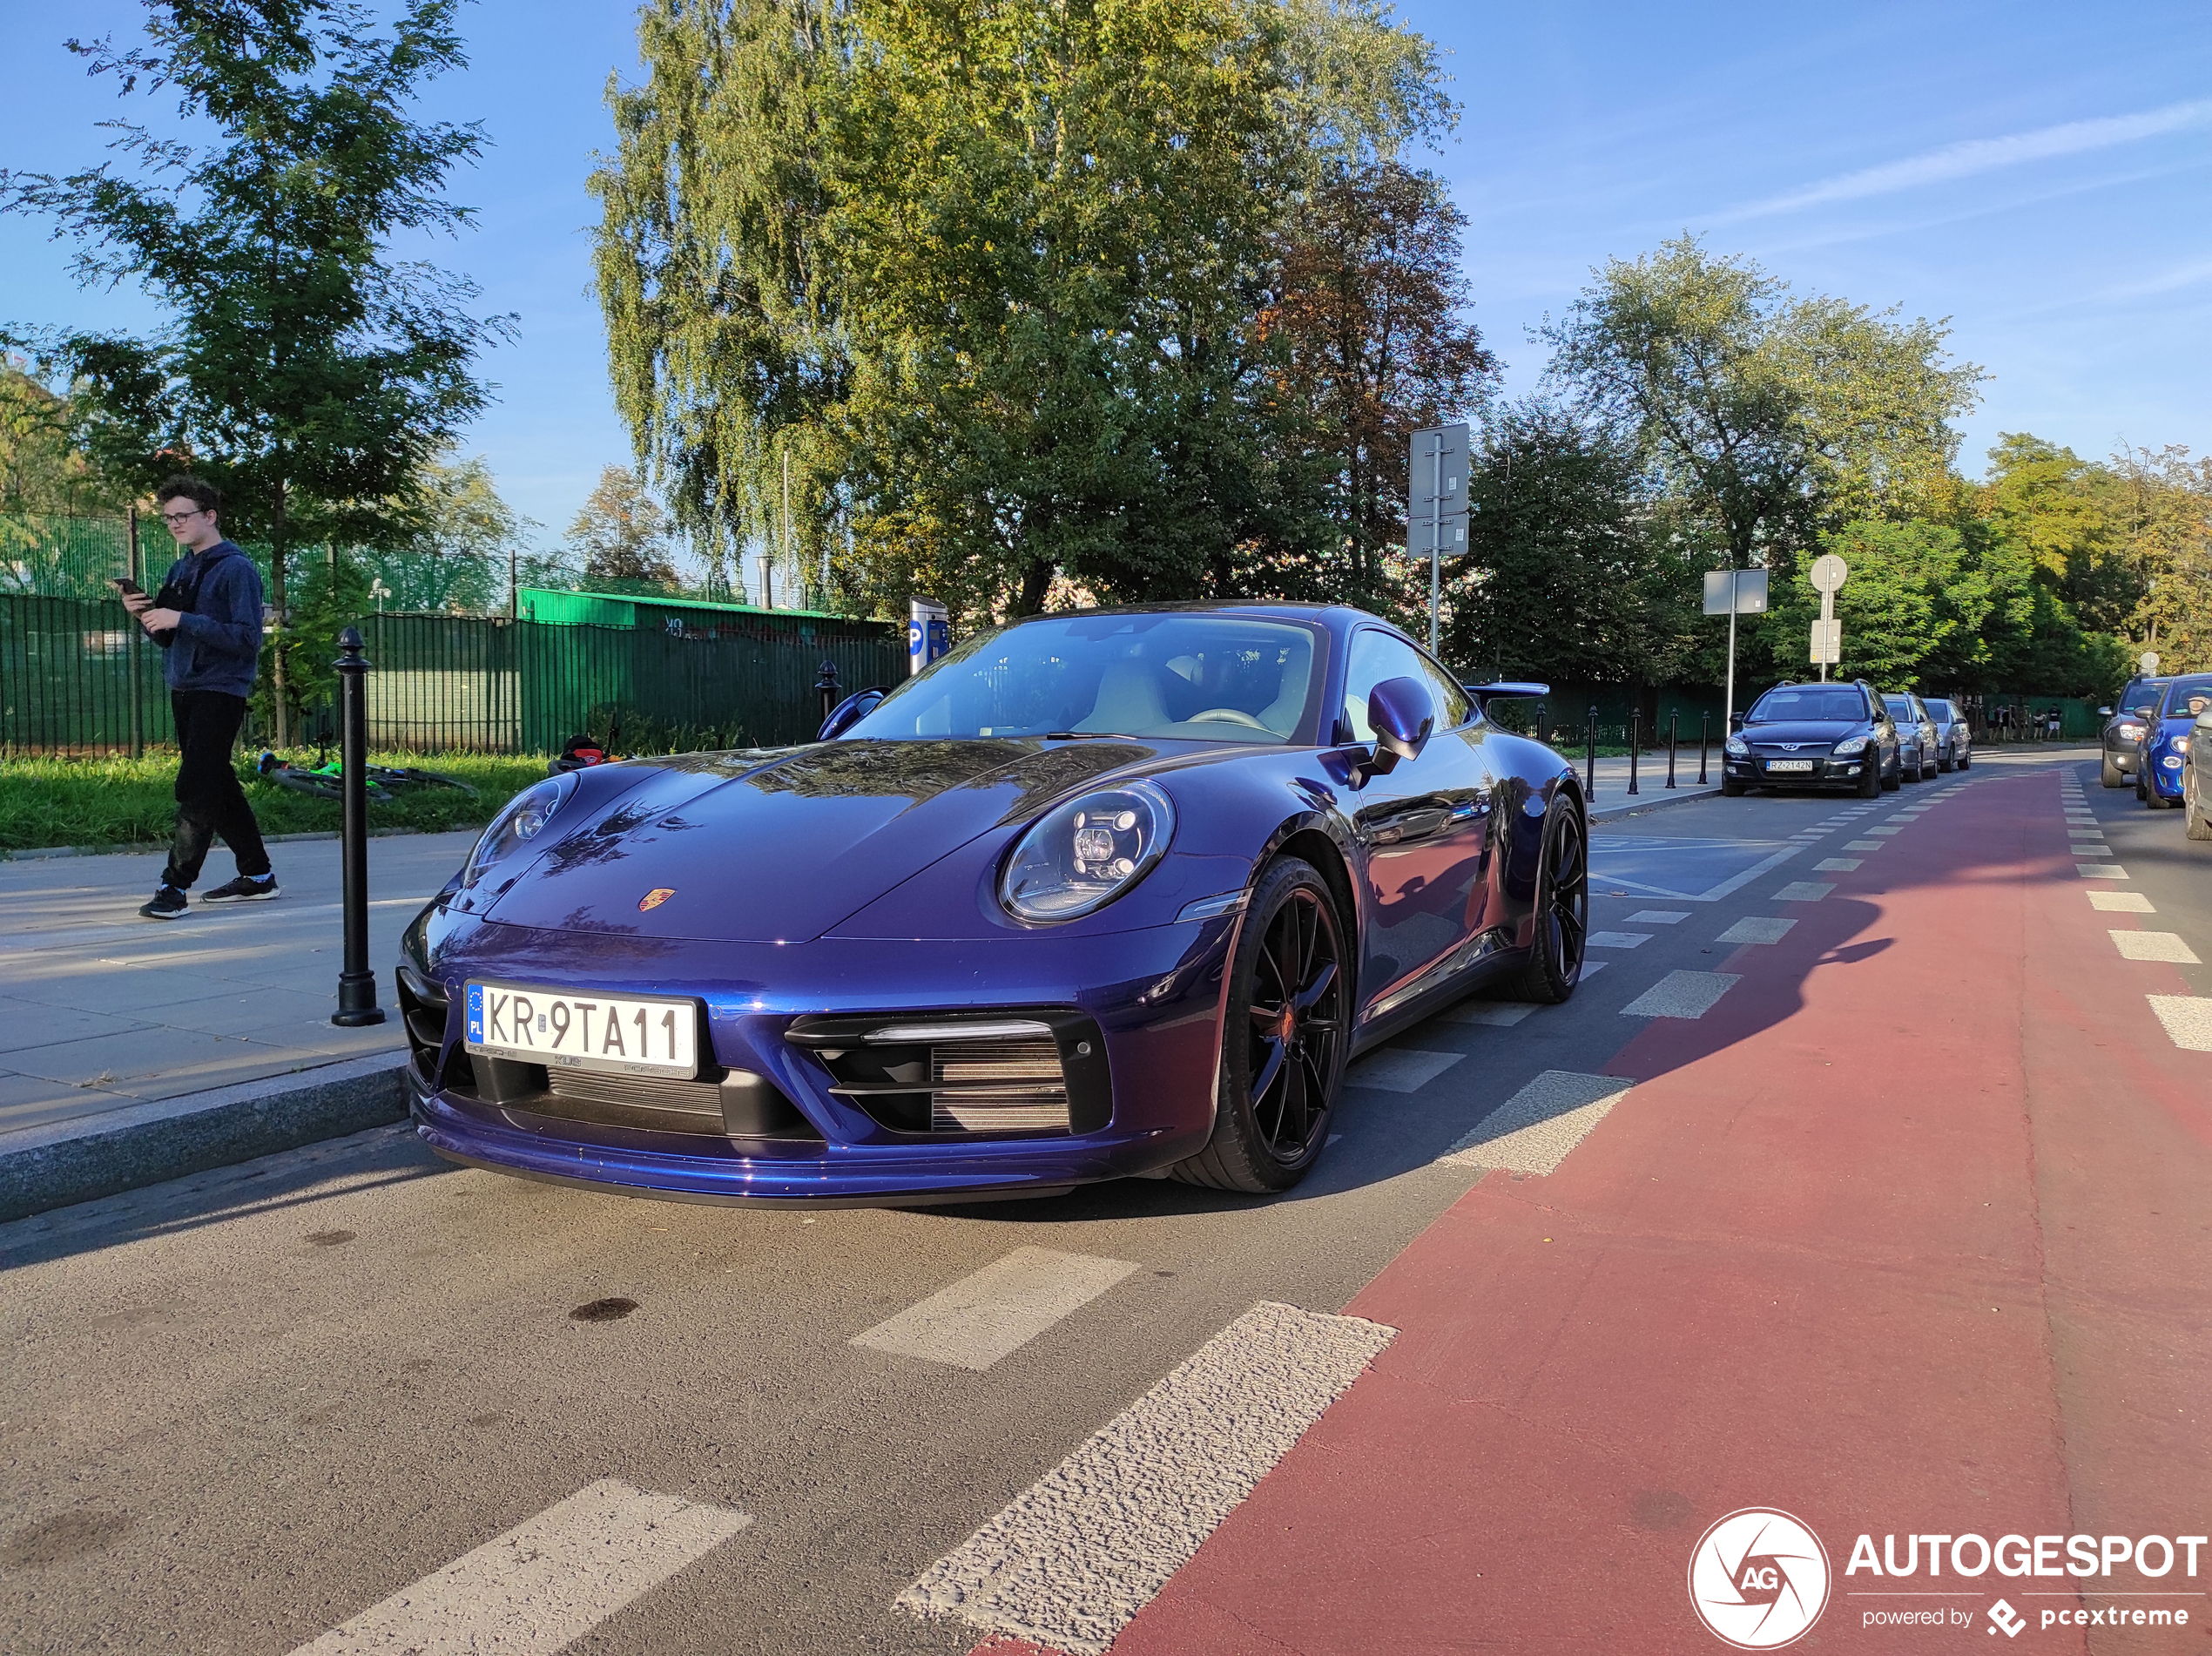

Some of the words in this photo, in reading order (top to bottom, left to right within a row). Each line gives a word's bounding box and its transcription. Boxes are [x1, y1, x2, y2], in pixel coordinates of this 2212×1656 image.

[910, 628, 921, 647] P
[470, 1020, 482, 1035] PL
[489, 992, 534, 1046] KR
[550, 1000, 676, 1061] 9TA11
